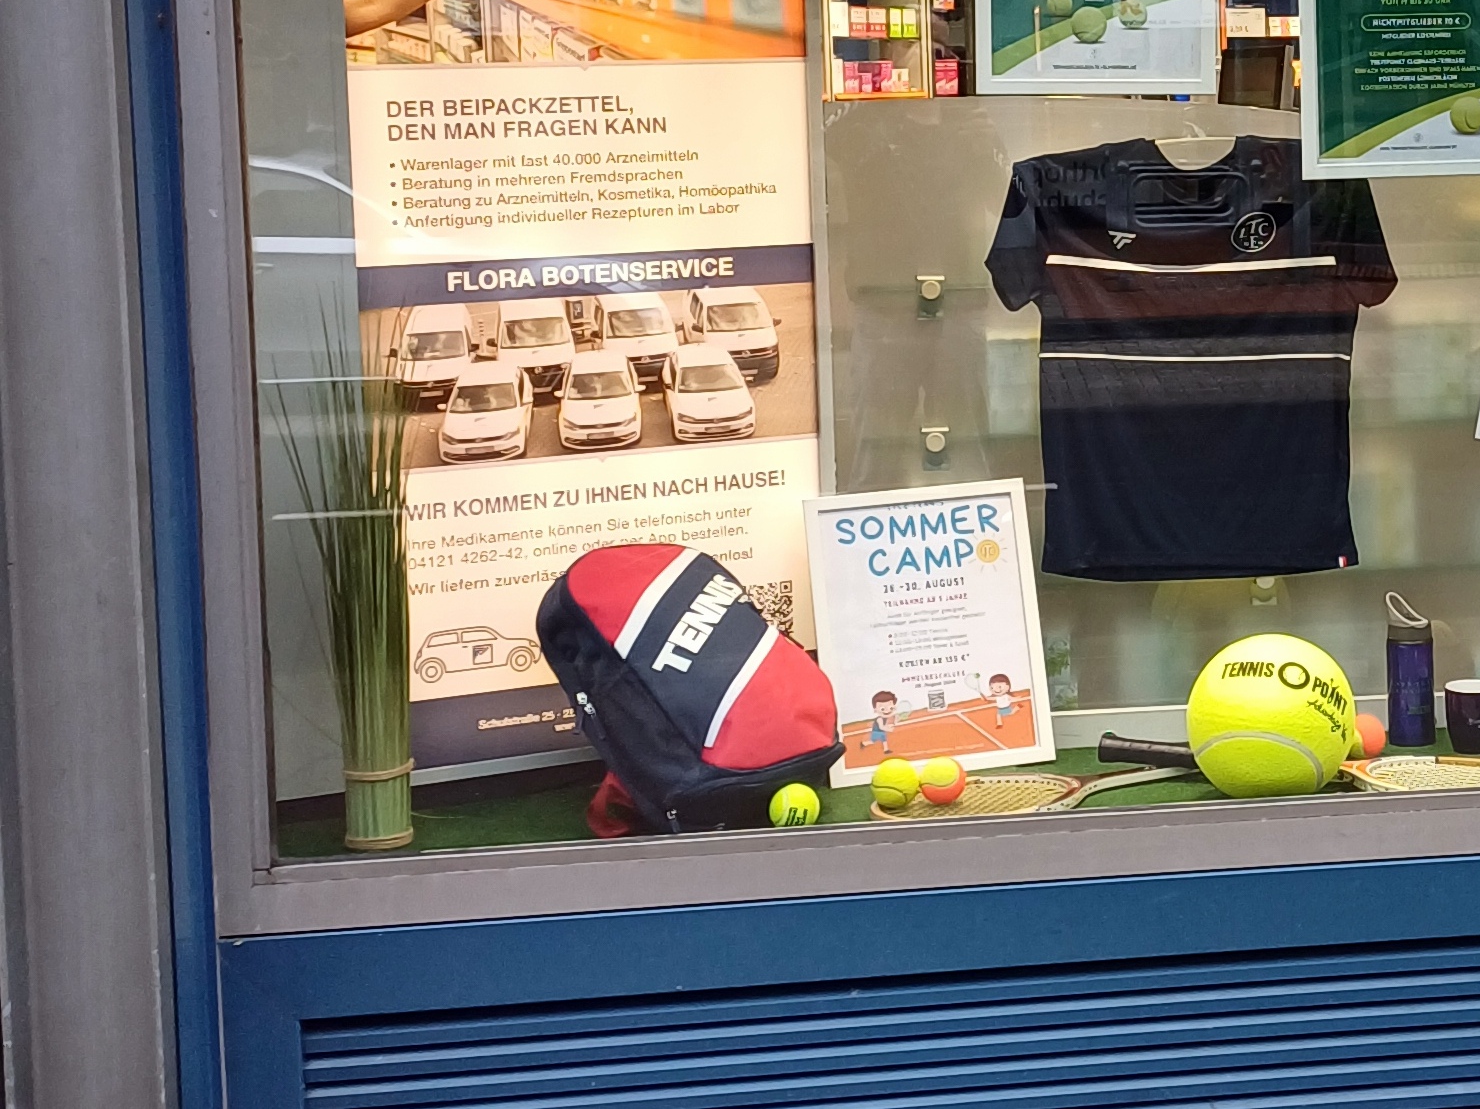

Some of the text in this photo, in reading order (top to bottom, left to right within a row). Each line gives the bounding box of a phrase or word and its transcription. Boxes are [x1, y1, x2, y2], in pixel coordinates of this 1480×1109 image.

[387, 95, 634, 118] DER BEIPACKZETTEL,
[388, 117, 667, 142] DEN MAN FRAGEN KANN
[400, 157, 488, 174] Warenlager
[493, 156, 516, 169] mit
[553, 152, 601, 167] 40.000
[606, 148, 698, 165] Arzneimitteln
[402, 168, 683, 193] Beratung in mehreren Fremdsprachen
[403, 195, 471, 212] Beratung
[475, 196, 492, 208] zu
[597, 186, 675, 203] Kosmetika,
[678, 183, 777, 200] Homöopathika
[404, 202, 739, 230] Anfertigung individueller Rezepturen im Labor
[447, 257, 734, 292] FLORA BOTENSERVICE
[405, 469, 786, 521] WIR KOMMEN ZU IHNEN NACH HAUSE!
[441, 526, 543, 548] Medikamente
[548, 519, 602, 539] können
[607, 517, 629, 531] Sie
[634, 510, 711, 528] telefonisch
[716, 506, 752, 521] unter
[835, 503, 1000, 546] SOMMER
[408, 554, 454, 570] 04121
[533, 541, 577, 557] online
[868, 539, 975, 577] CAMP
[409, 582, 435, 596] Wir
[440, 576, 490, 592] liefern
[925, 577, 965, 590] AUGUST
[1221, 661, 1348, 716] TENNIS POINT
